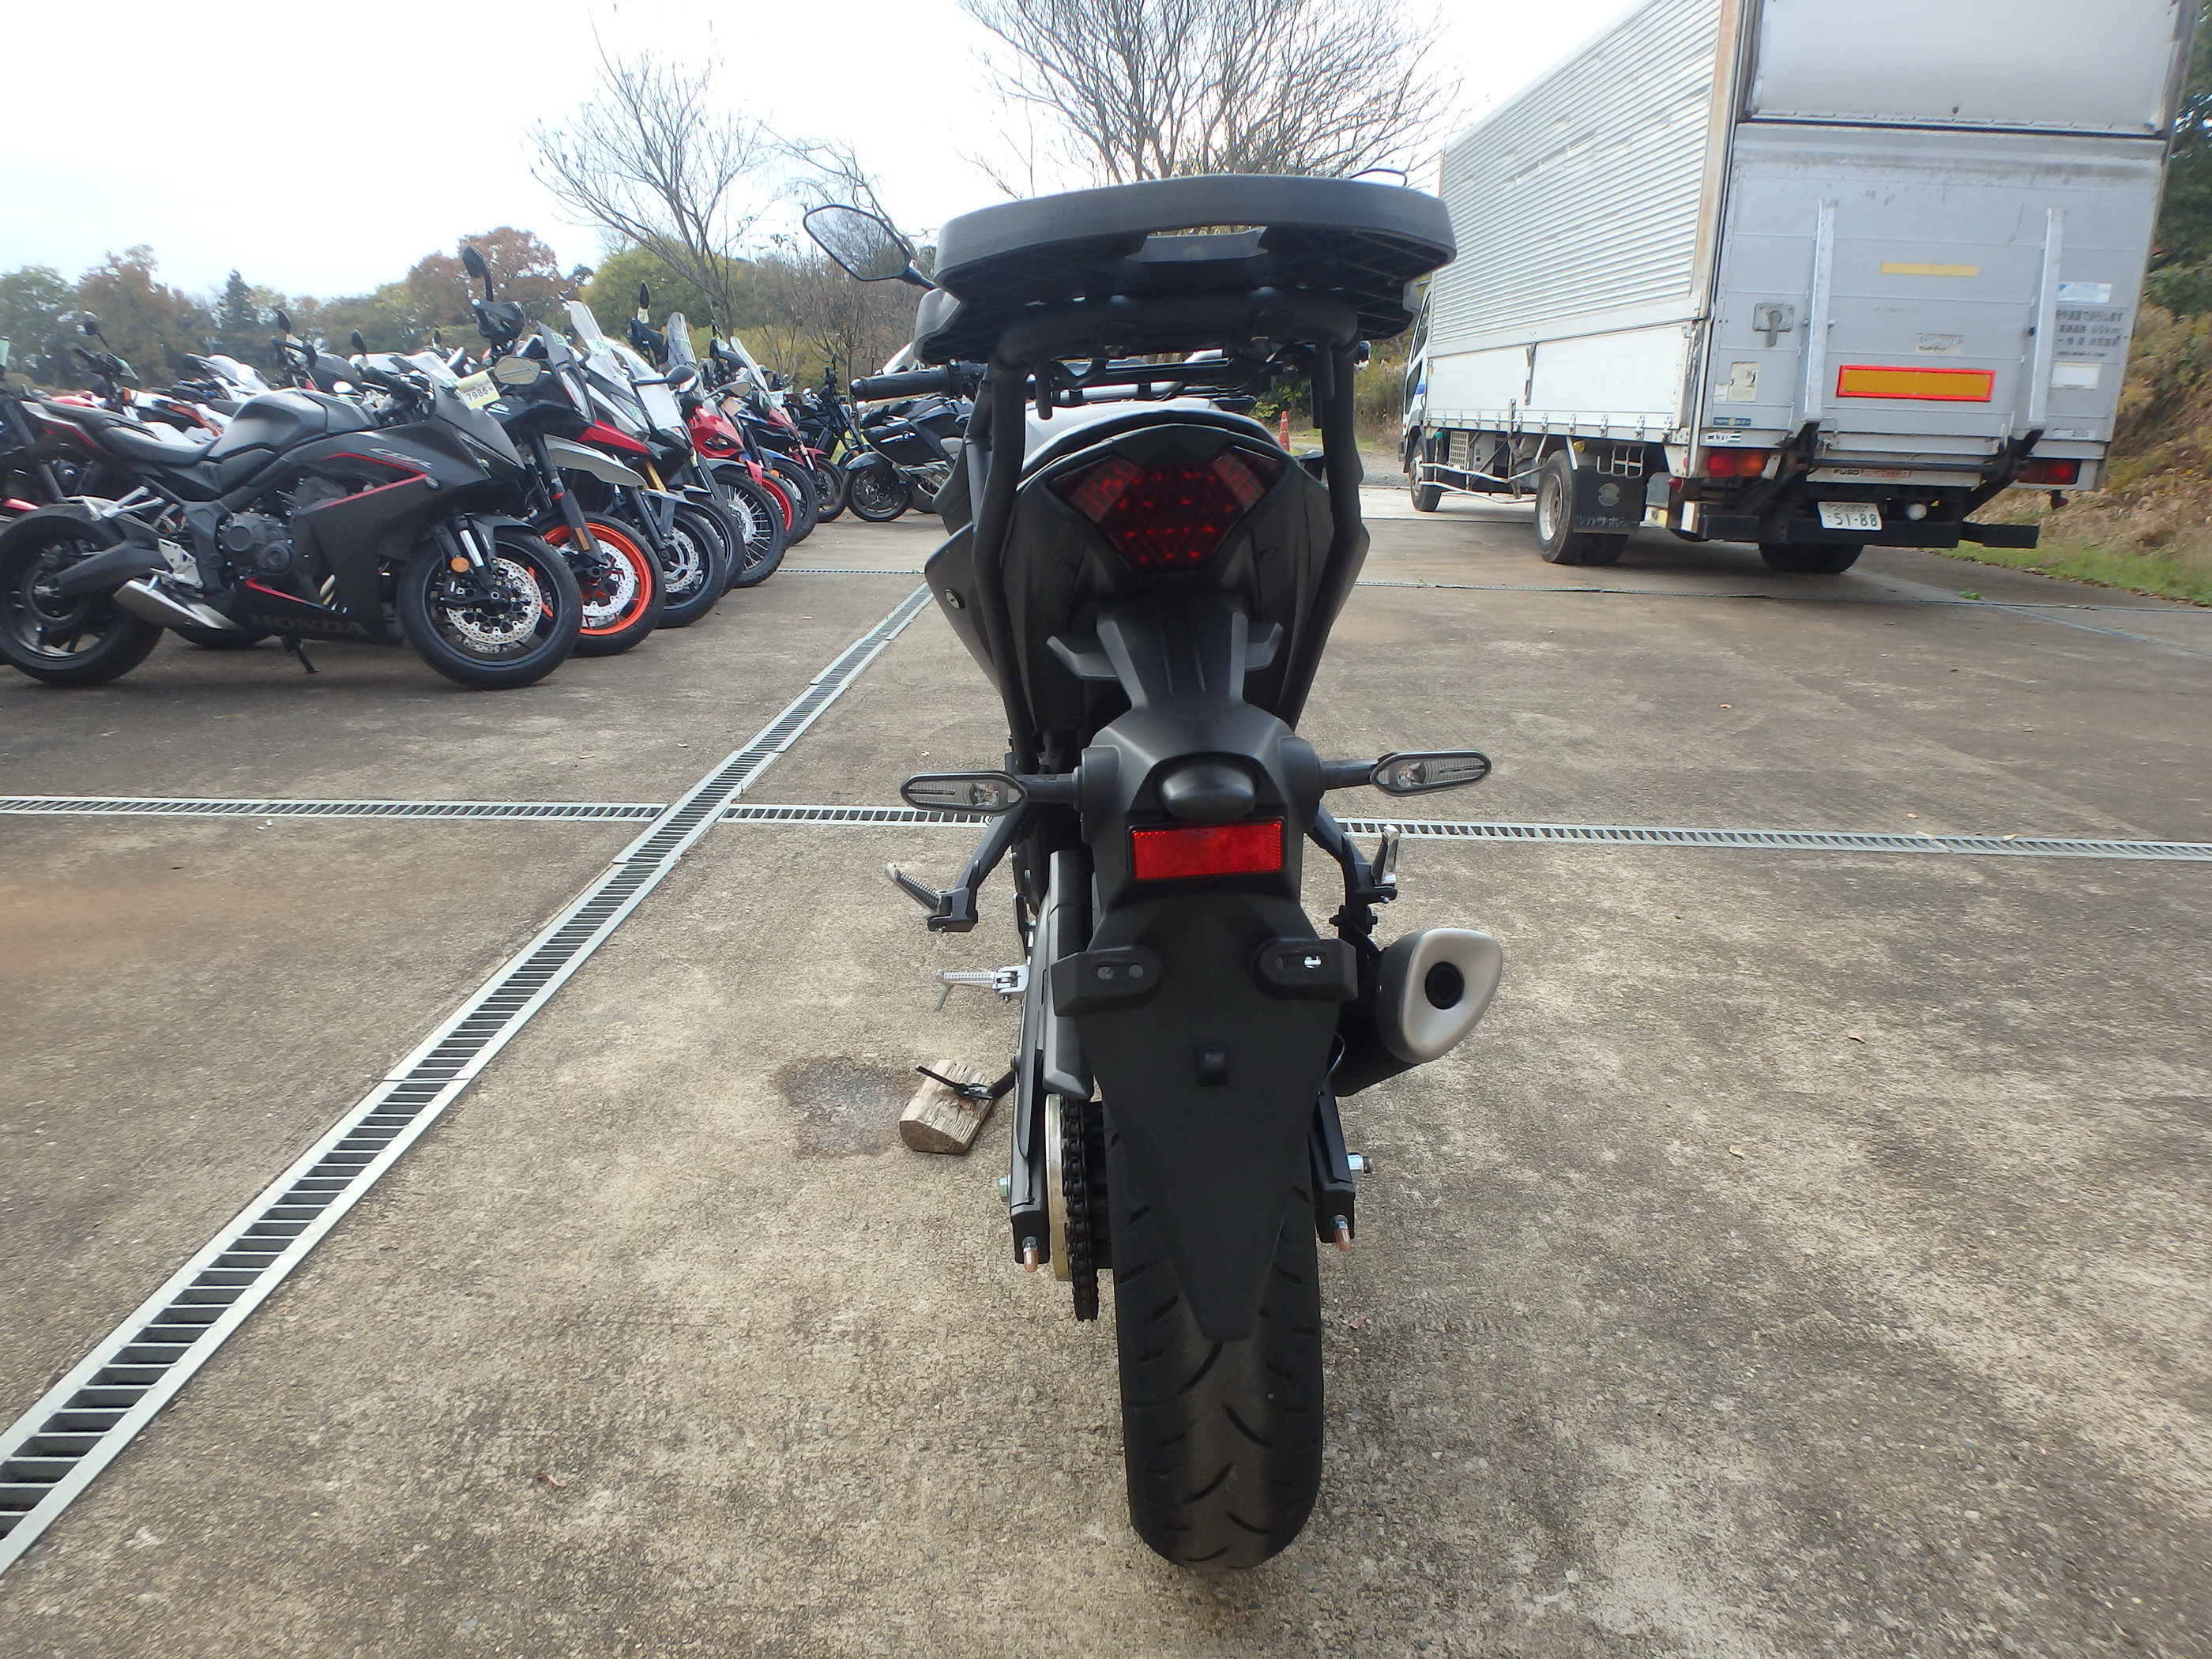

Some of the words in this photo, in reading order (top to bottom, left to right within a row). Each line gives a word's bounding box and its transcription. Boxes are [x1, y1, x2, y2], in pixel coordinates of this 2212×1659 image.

[465, 386, 489, 401] 7986
[1833, 513, 1878, 528] 51-88
[248, 613, 372, 635] HONDA
